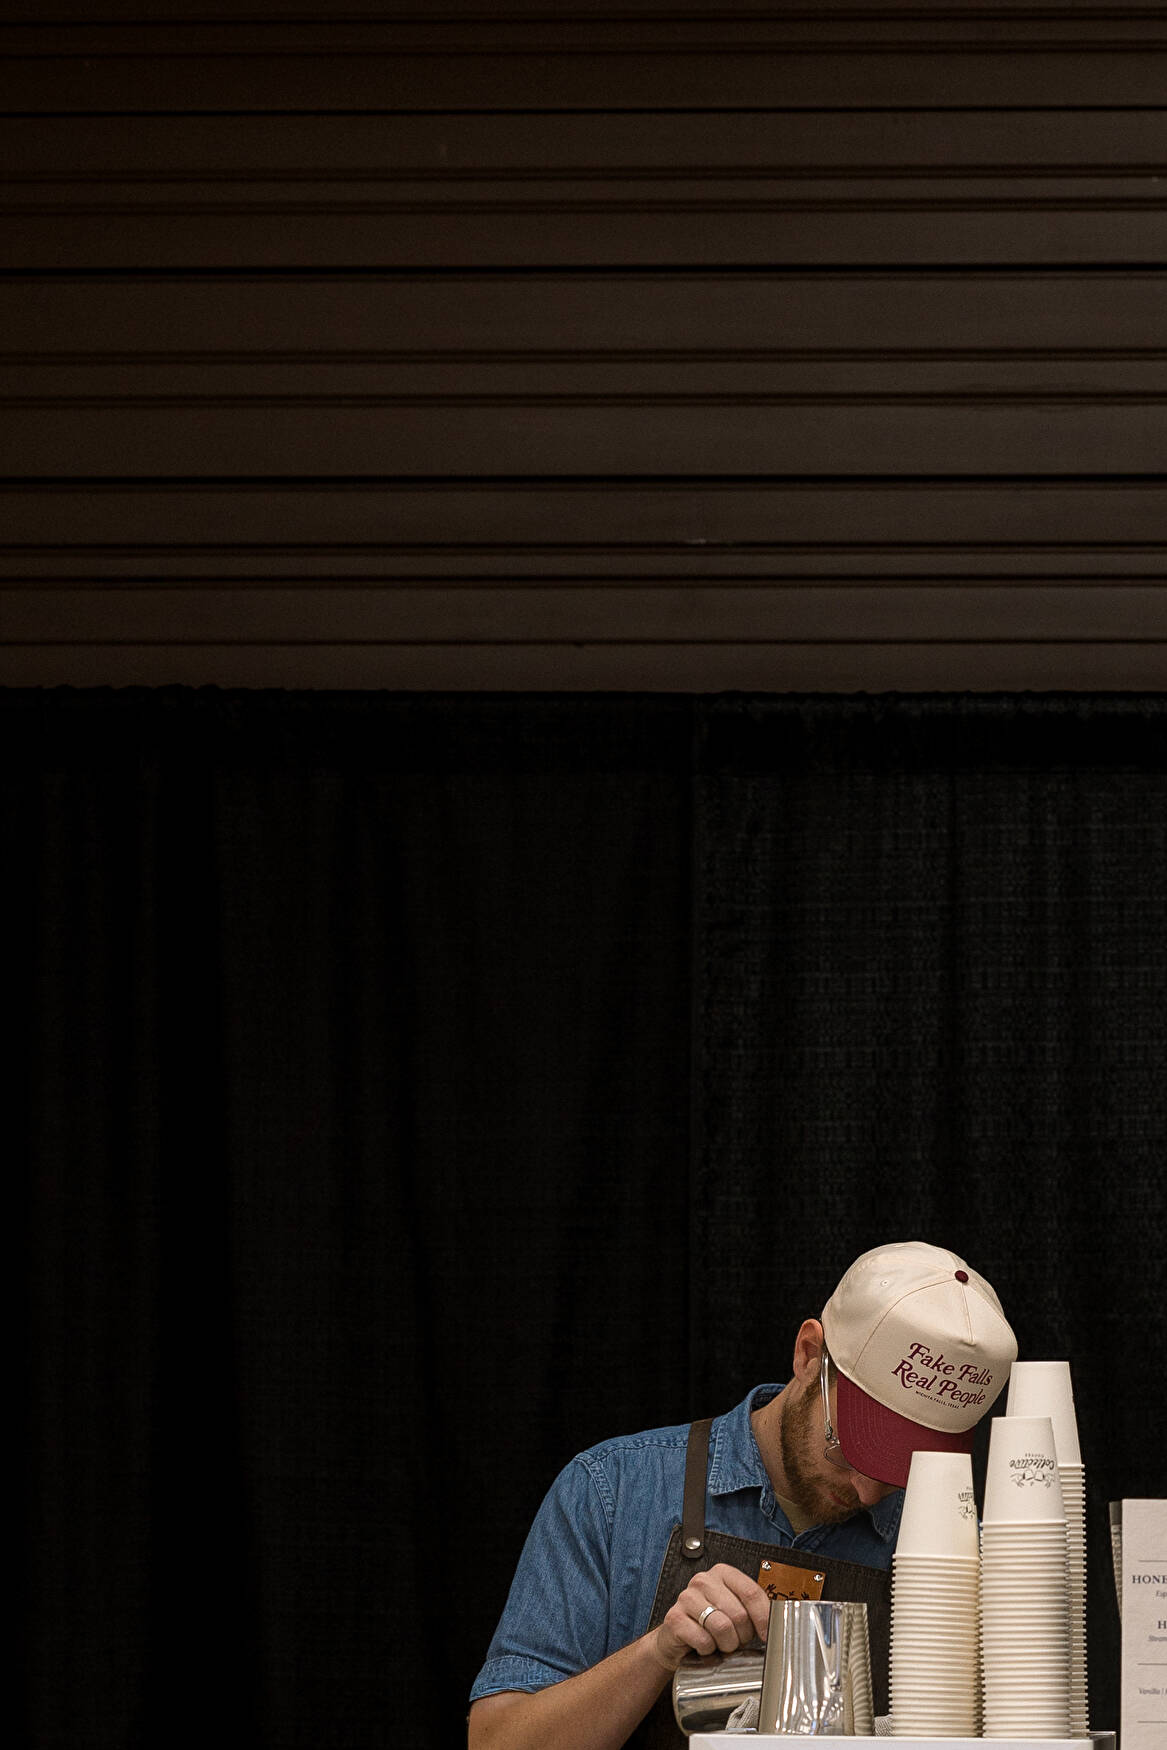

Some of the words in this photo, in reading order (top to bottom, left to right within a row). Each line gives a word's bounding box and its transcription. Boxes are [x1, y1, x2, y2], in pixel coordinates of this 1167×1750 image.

[891, 1360, 937, 1391] Real
[937, 1378, 986, 1408] People
[909, 1342, 955, 1376] Fake
[957, 1364, 993, 1386] Falls
